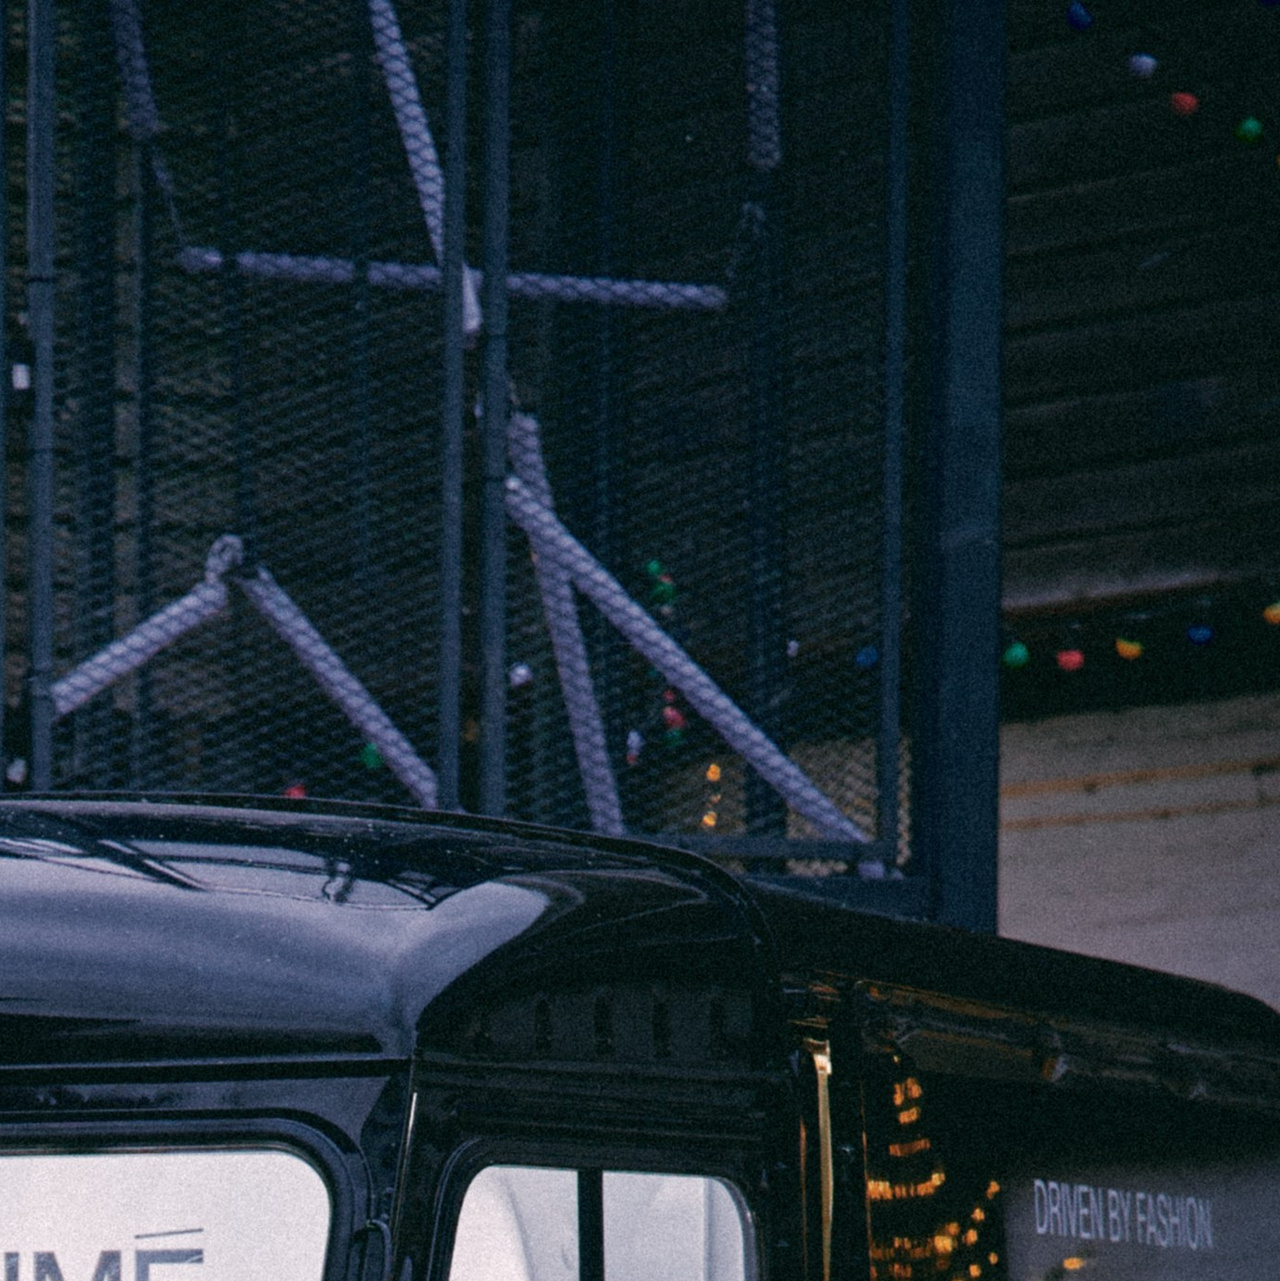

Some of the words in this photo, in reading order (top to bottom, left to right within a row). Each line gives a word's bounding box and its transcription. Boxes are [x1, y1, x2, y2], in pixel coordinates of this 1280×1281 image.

[1034, 1179, 1104, 1239] DRIVEN
[1108, 1189, 1130, 1243] BY
[1136, 1191, 1213, 1250] FASHION
